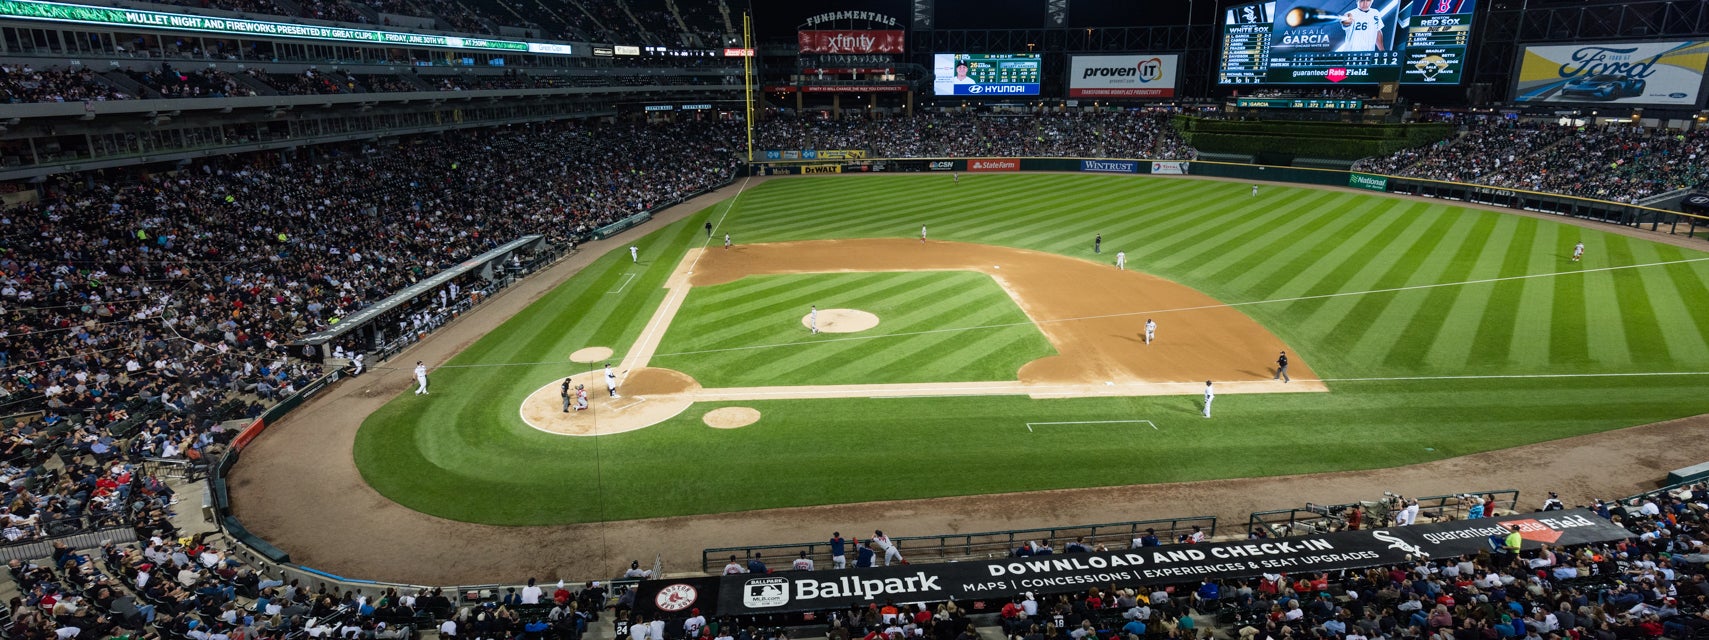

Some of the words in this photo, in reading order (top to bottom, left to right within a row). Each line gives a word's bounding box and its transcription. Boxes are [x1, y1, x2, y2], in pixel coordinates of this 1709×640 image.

[126, 12, 168, 24] MULLET
[170, 16, 202, 28] NIGHT
[204, 19, 224, 29] AND
[226, 21, 276, 33] FIREWORKS
[277, 26, 320, 36] PRESENTED
[321, 29, 330, 37] BY
[332, 30, 354, 38] GREAT
[806, 11, 896, 26] FUNDAMENTALS
[1355, 22, 1368, 30] 26
[828, 34, 875, 50] xfinity
[1283, 35, 1329, 44] GARCIA
[1558, 46, 1663, 78] Ford
[1082, 67, 1137, 79] proven
[1144, 65, 1156, 76] IT
[1293, 69, 1328, 77] guaranteed
[1085, 161, 1133, 170] WINTRUST
[1358, 177, 1385, 186] National
[1423, 524, 1511, 544] guaranteed
[1540, 515, 1595, 529] Field
[988, 552, 1144, 577] DOWNLOAD
[1153, 549, 1204, 564] AND
[1211, 538, 1333, 559] CHECK-IN
[963, 580, 1006, 592] MAPS
[1021, 572, 1131, 588] CONCESSIONS
[1146, 562, 1245, 578] EXPERIENCES
[1249, 561, 1258, 569] &
[1262, 557, 1298, 568] SEAT
[1302, 551, 1379, 565] UPGRADES
[661, 586, 691, 595] BOSTON
[795, 572, 941, 600] Ballpark
[678, 599, 692, 608] SOX
[617, 626, 627, 634] 24
